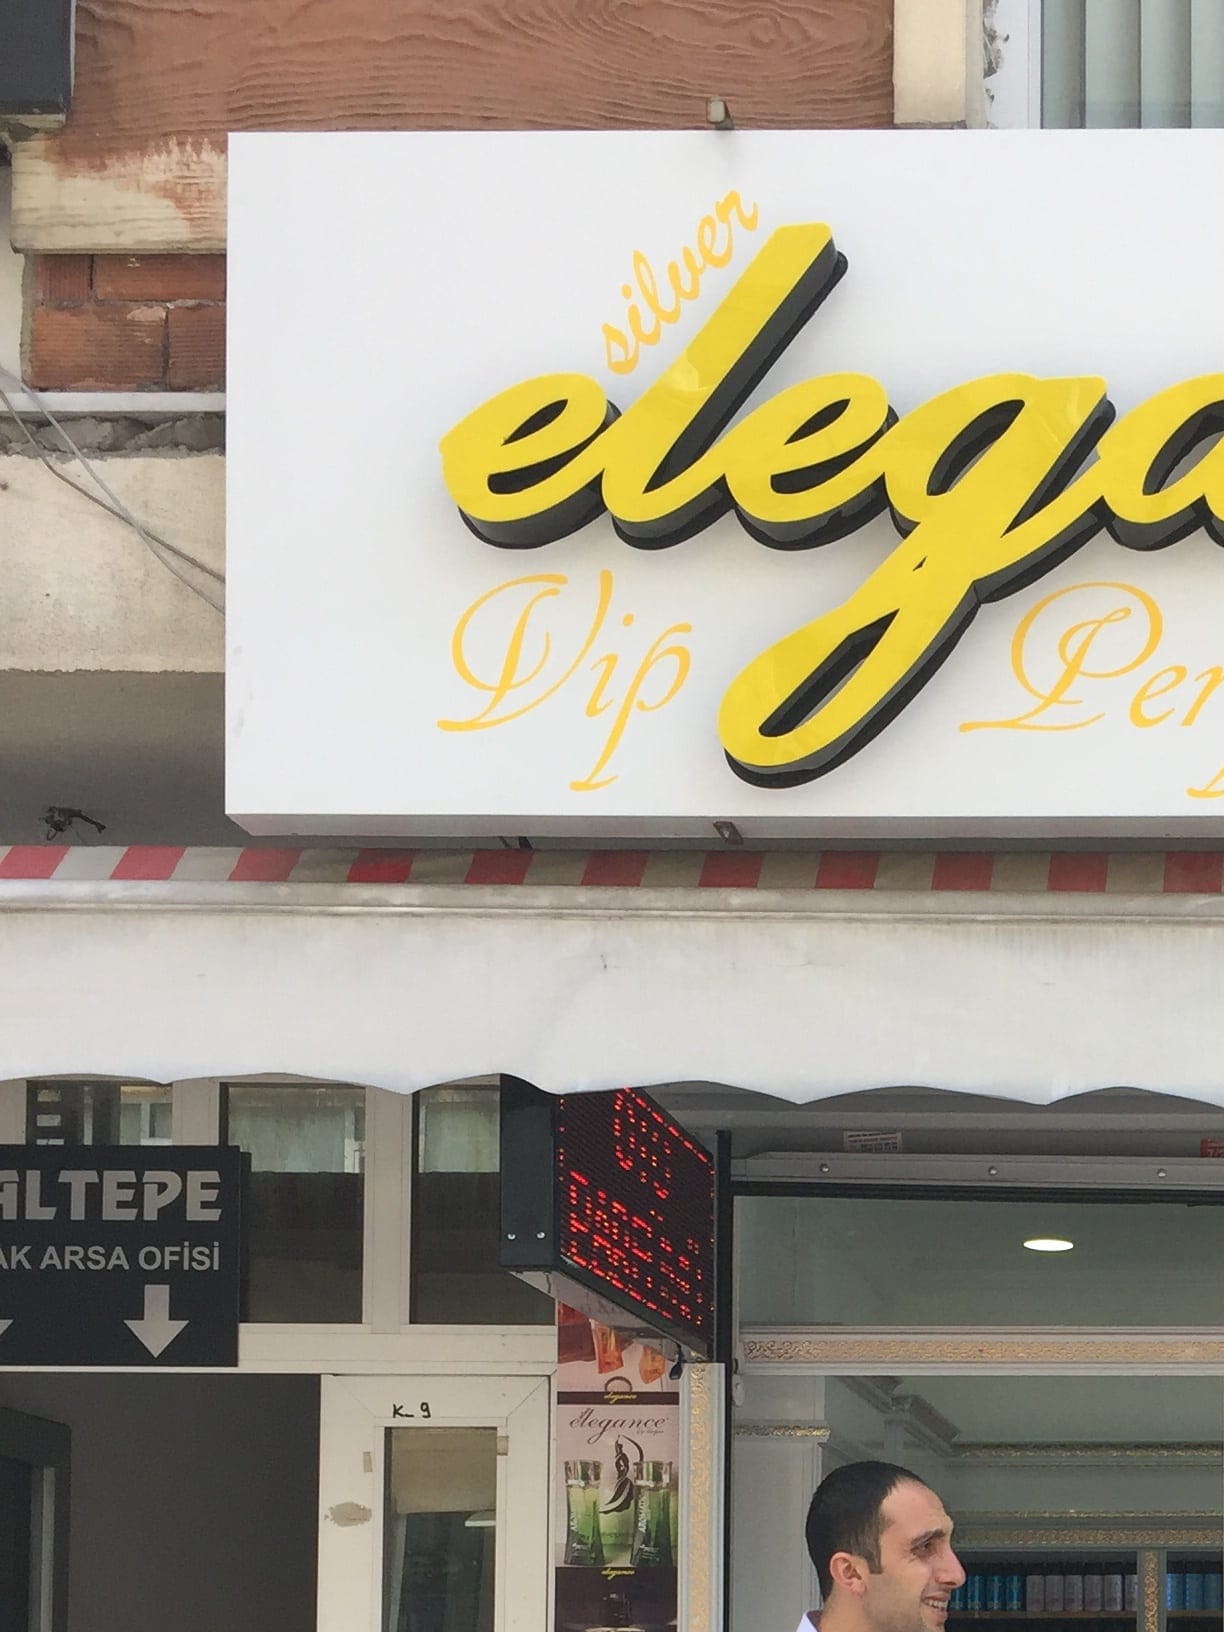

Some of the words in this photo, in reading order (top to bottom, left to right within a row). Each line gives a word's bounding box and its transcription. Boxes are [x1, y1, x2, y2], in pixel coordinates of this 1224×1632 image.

[602, 189, 759, 375] silver
[436, 569, 692, 793] Vip
[40, 1245, 131, 1271] ARSA
[138, 1240, 220, 1271] OFİSİ
